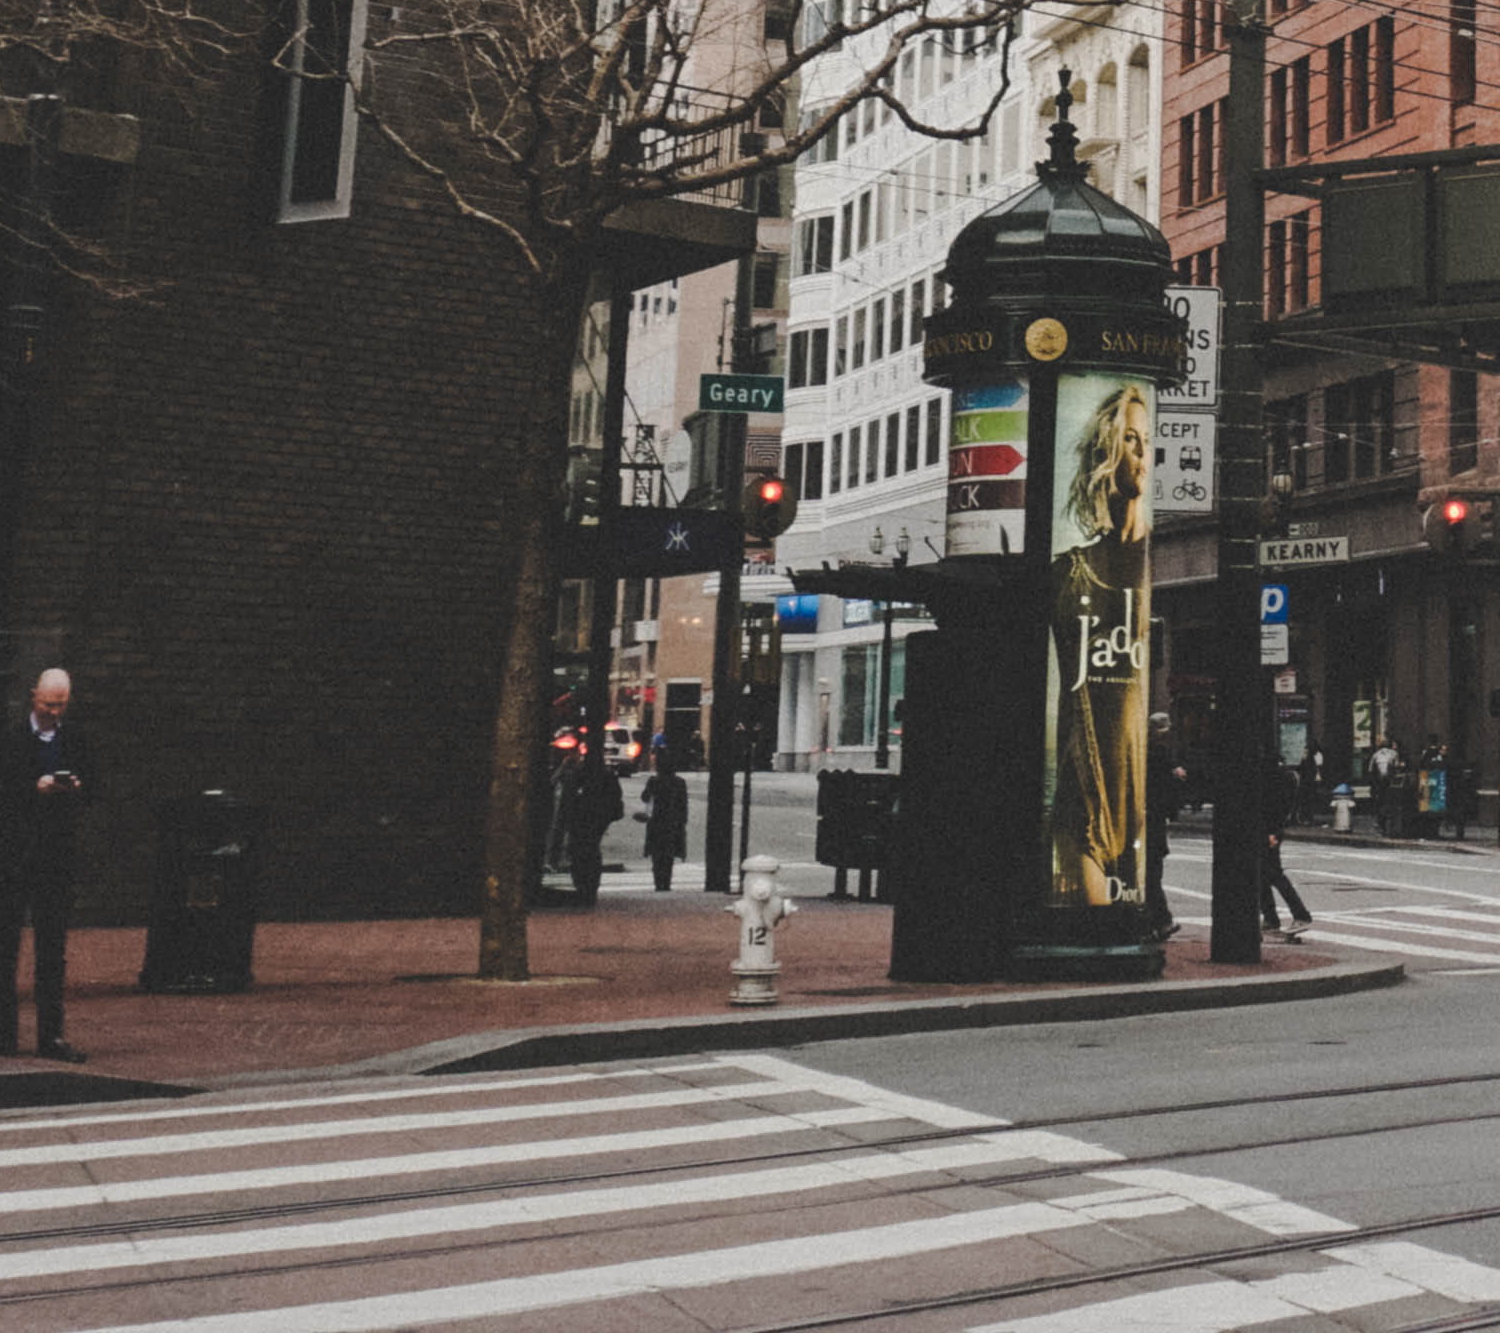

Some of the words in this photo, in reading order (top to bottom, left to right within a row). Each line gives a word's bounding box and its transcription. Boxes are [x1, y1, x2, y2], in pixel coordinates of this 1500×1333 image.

[1102, 330, 1139, 351] SAN
[709, 383, 774, 408] Geary
[1160, 423, 1200, 438] CEPT
[1267, 540, 1341, 561] KEARNY
[748, 925, 767, 946] 12
